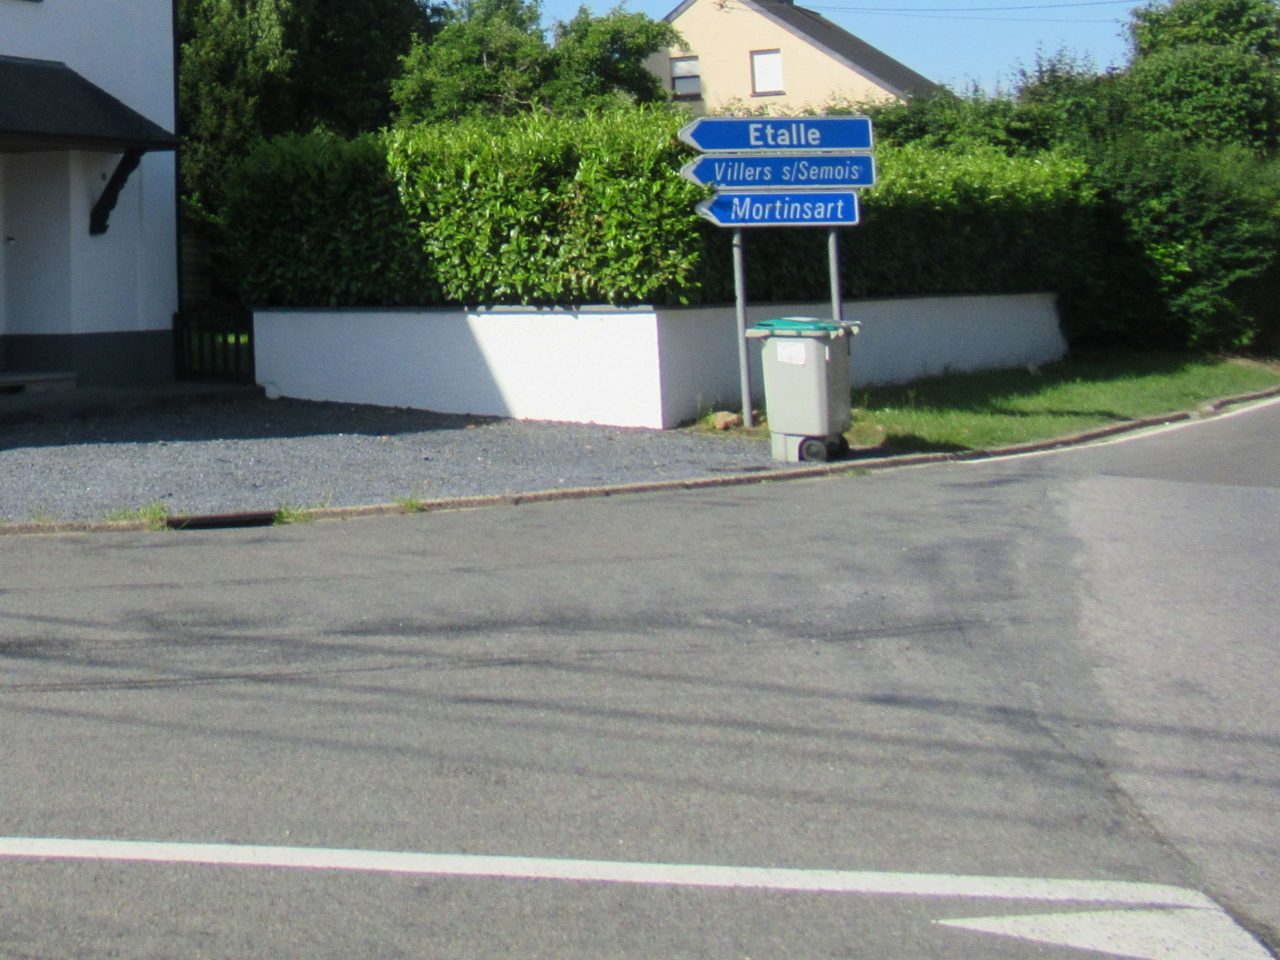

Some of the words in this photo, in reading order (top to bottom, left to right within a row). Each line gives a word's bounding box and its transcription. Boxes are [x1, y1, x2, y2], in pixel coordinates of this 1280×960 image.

[748, 123, 821, 146] Etalle
[714, 162, 772, 181] Villers
[781, 161, 860, 182] s/Semois
[731, 197, 844, 220] Mortinsart
